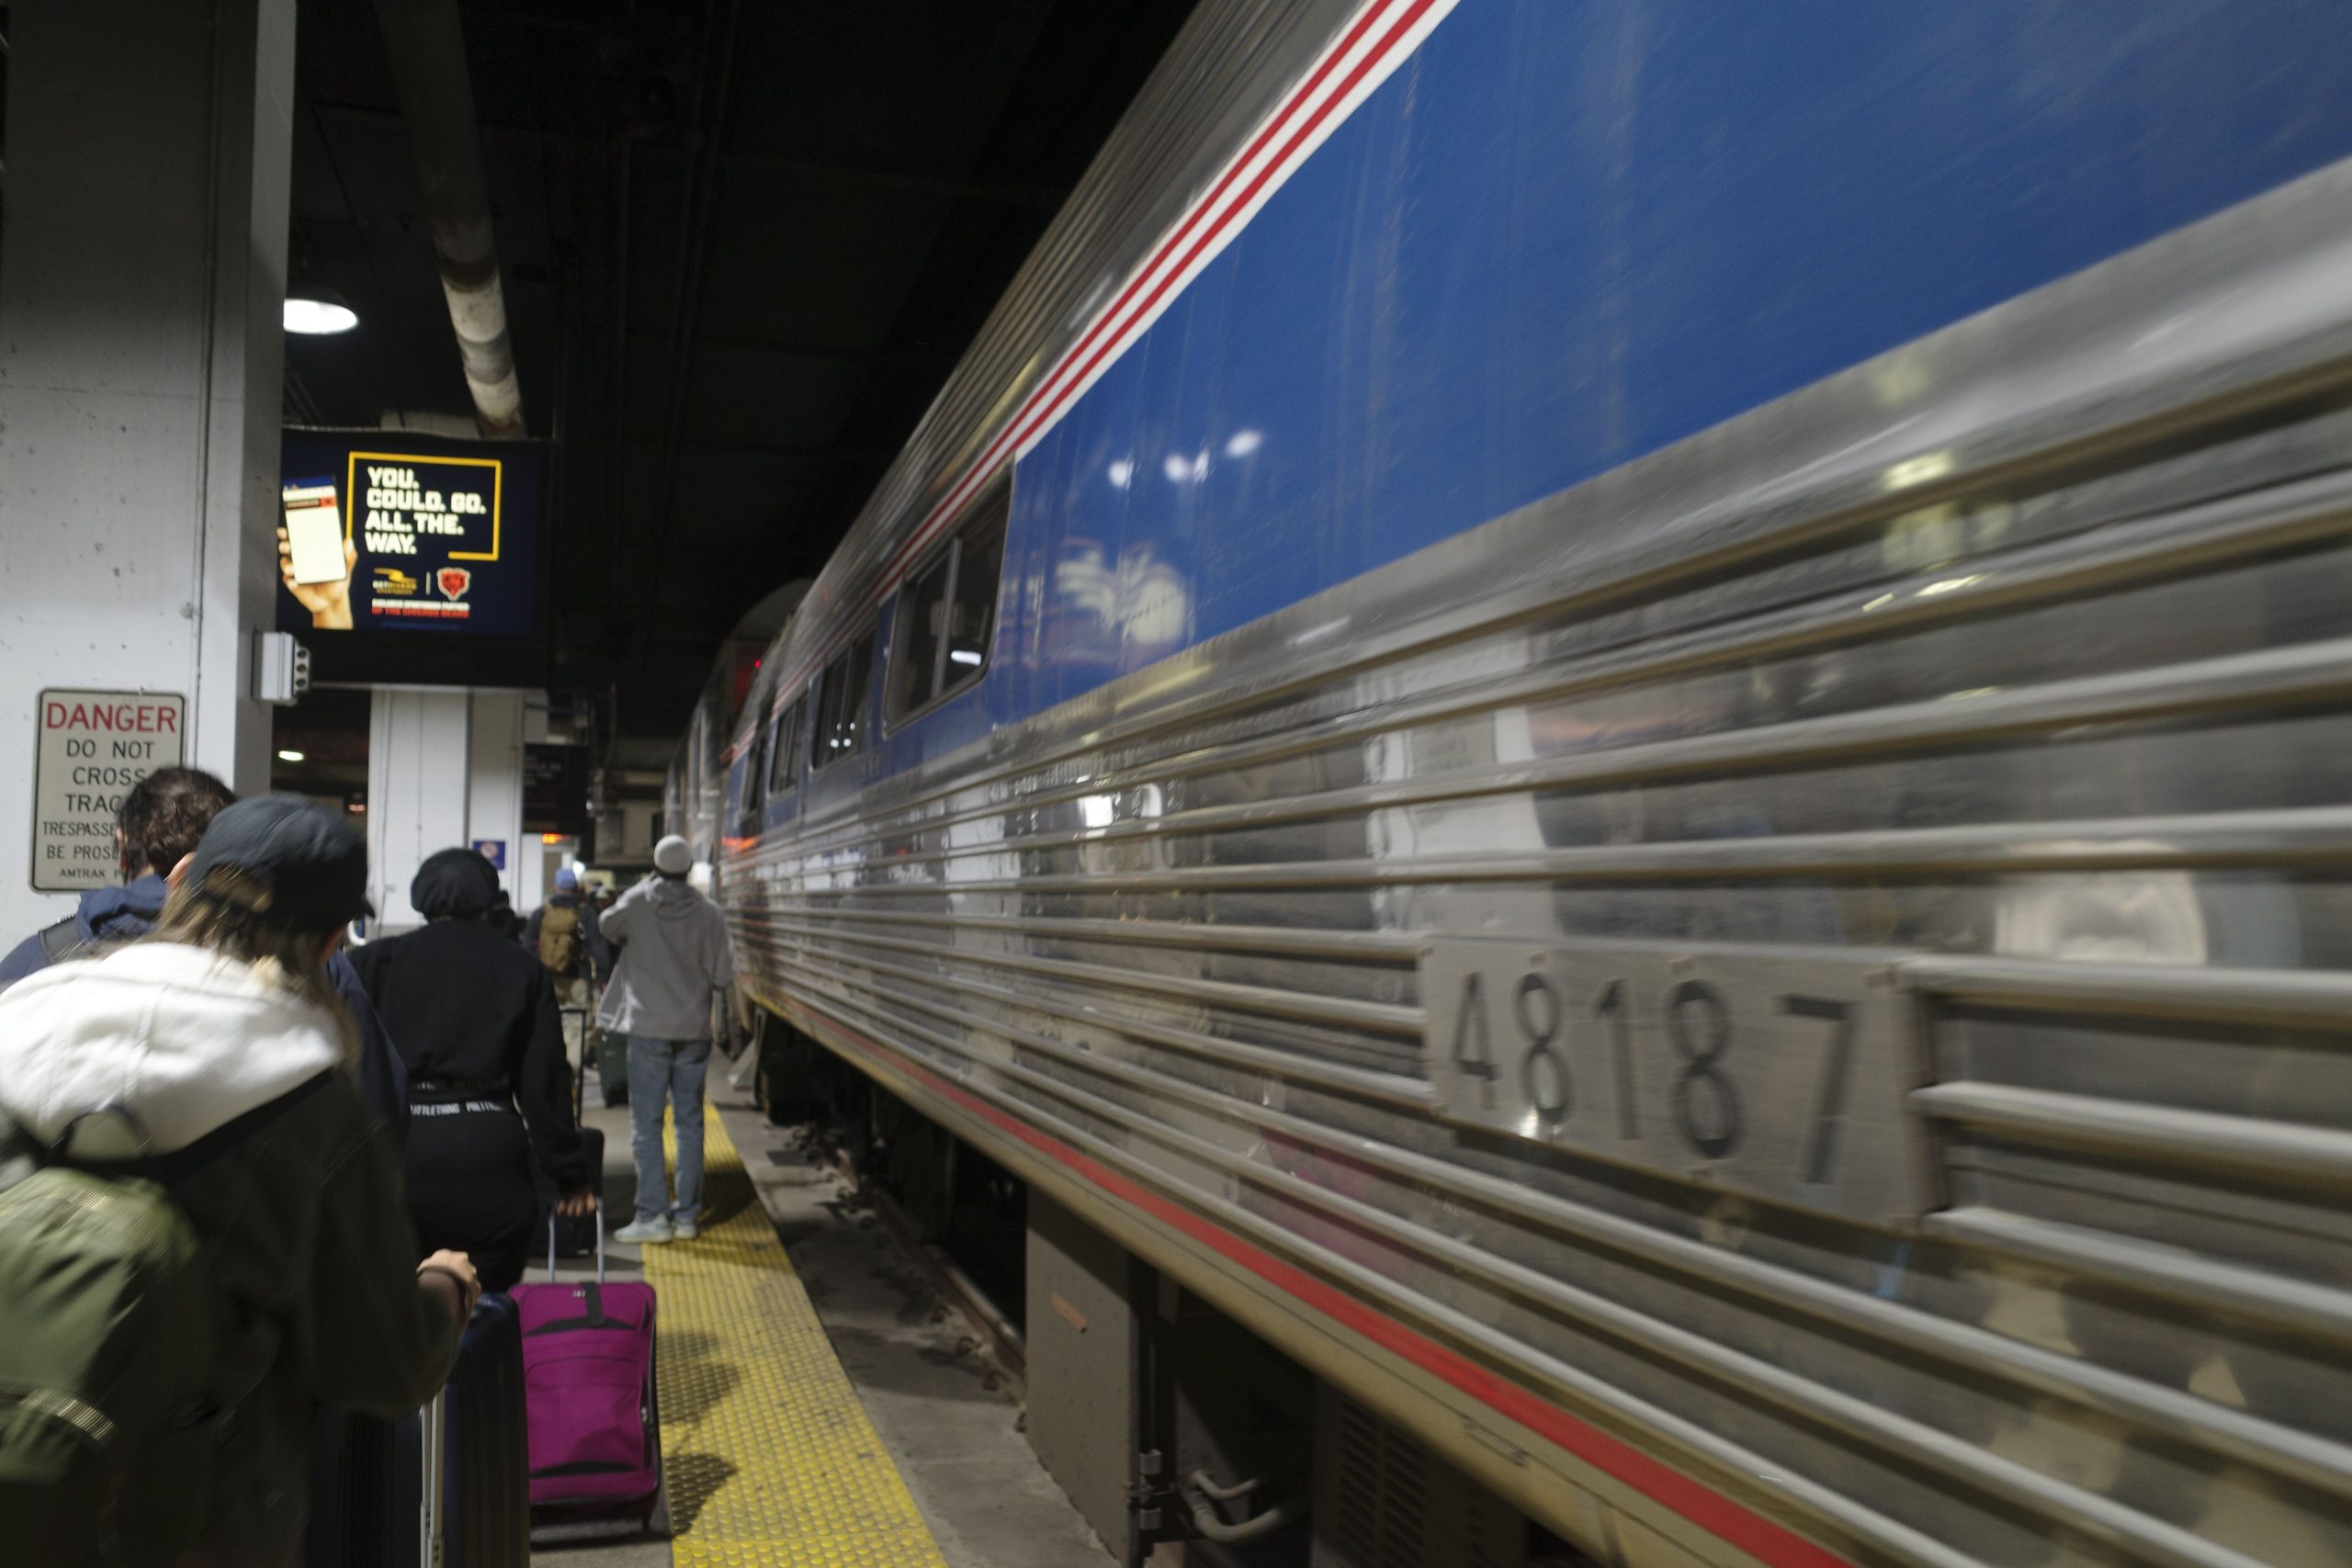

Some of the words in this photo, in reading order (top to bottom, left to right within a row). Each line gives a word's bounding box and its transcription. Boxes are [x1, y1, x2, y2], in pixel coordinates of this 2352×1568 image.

[368, 467, 419, 490] YOU.
[367, 489, 447, 513] COULD.
[451, 492, 486, 514] GO.
[365, 511, 413, 533] ALL.
[413, 512, 464, 536] THE.
[365, 532, 417, 554] WAY.
[46, 702, 176, 733] DANGER
[66, 739, 96, 758] DO
[112, 740, 154, 760] NOT
[65, 794, 121, 813] TRAC
[42, 821, 117, 837] TRESPASSE
[47, 845, 65, 859] BE
[74, 845, 119, 861] PROSE
[60, 867, 105, 878] AMTRAK
[1452, 970, 1856, 1184] 48187
